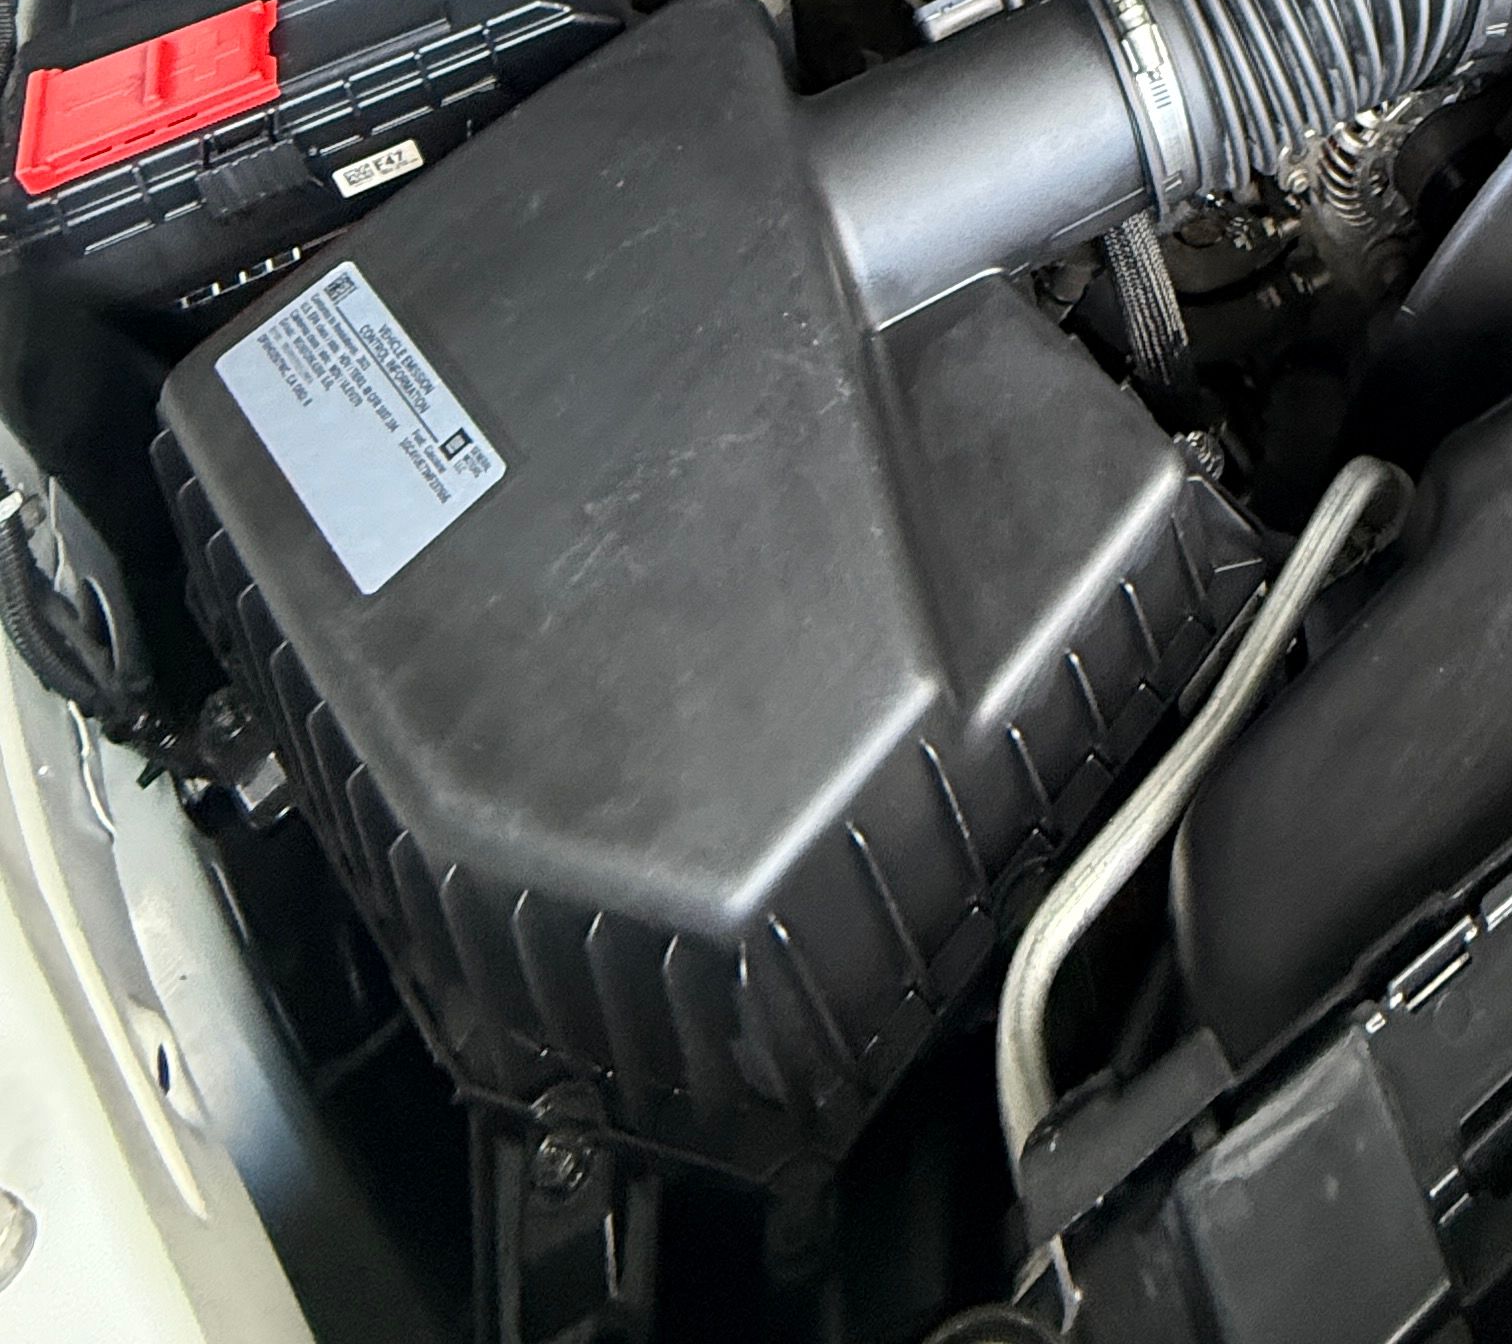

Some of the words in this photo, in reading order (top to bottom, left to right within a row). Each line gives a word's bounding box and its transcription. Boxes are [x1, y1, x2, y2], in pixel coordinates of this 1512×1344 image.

[358, 323, 391, 362] CONTROL
[385, 358, 430, 414] INFORMATION
[377, 324, 406, 358] VEHICLE
[401, 355, 434, 395] EMISSION
